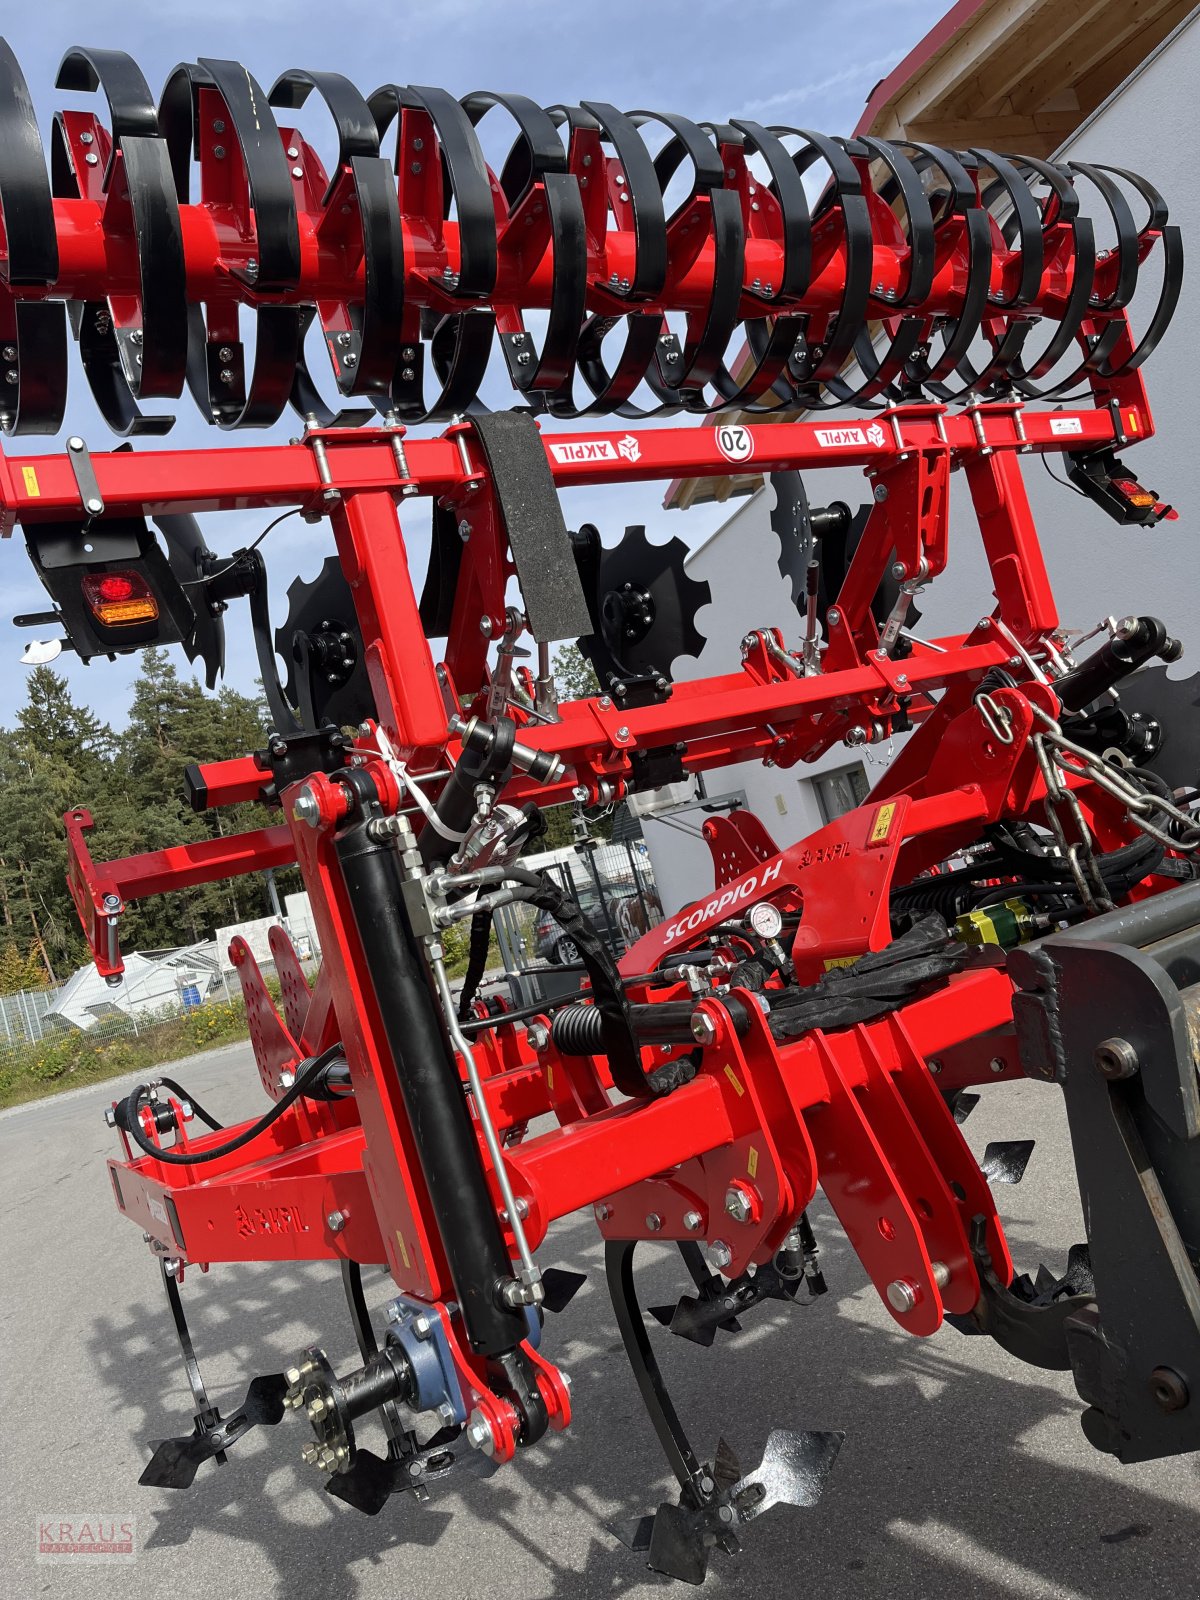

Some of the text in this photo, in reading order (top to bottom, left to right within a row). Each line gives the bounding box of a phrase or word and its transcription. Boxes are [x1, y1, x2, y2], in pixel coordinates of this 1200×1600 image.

[721, 430, 748, 452] 20
[821, 431, 861, 445] AKPIL
[558, 443, 608, 460] AKPIL
[663, 876, 757, 945] SCORPIO
[760, 859, 783, 888] H
[254, 1206, 310, 1234] AKPIL
